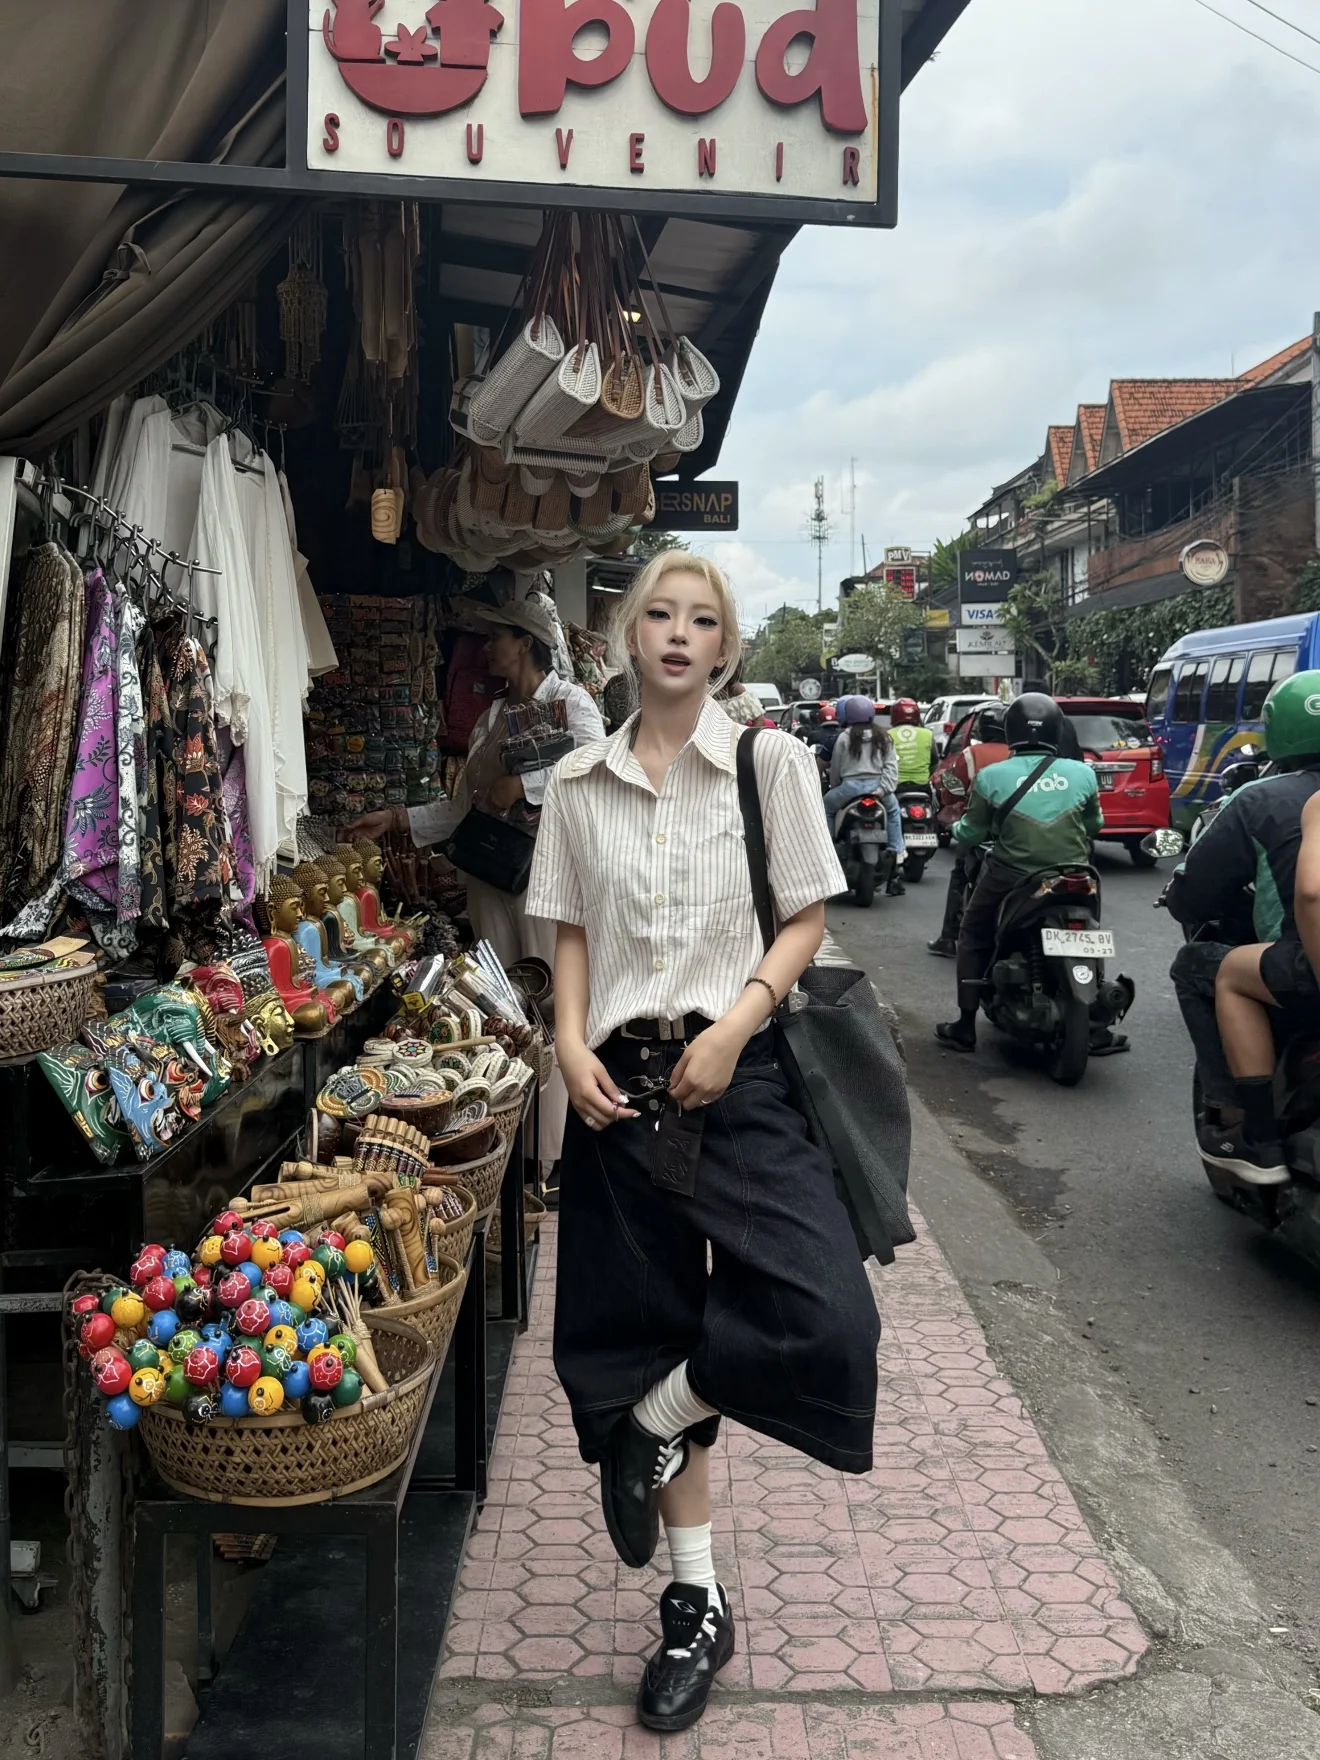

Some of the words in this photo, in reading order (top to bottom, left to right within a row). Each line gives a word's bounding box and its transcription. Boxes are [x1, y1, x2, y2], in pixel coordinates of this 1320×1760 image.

[322, 112, 861, 186] SOUVENIR
[703, 514, 731, 523] BALI
[965, 608, 994, 620] VISA
[1046, 930, 1061, 942] DK
[1065, 932, 1092, 944] 2745
